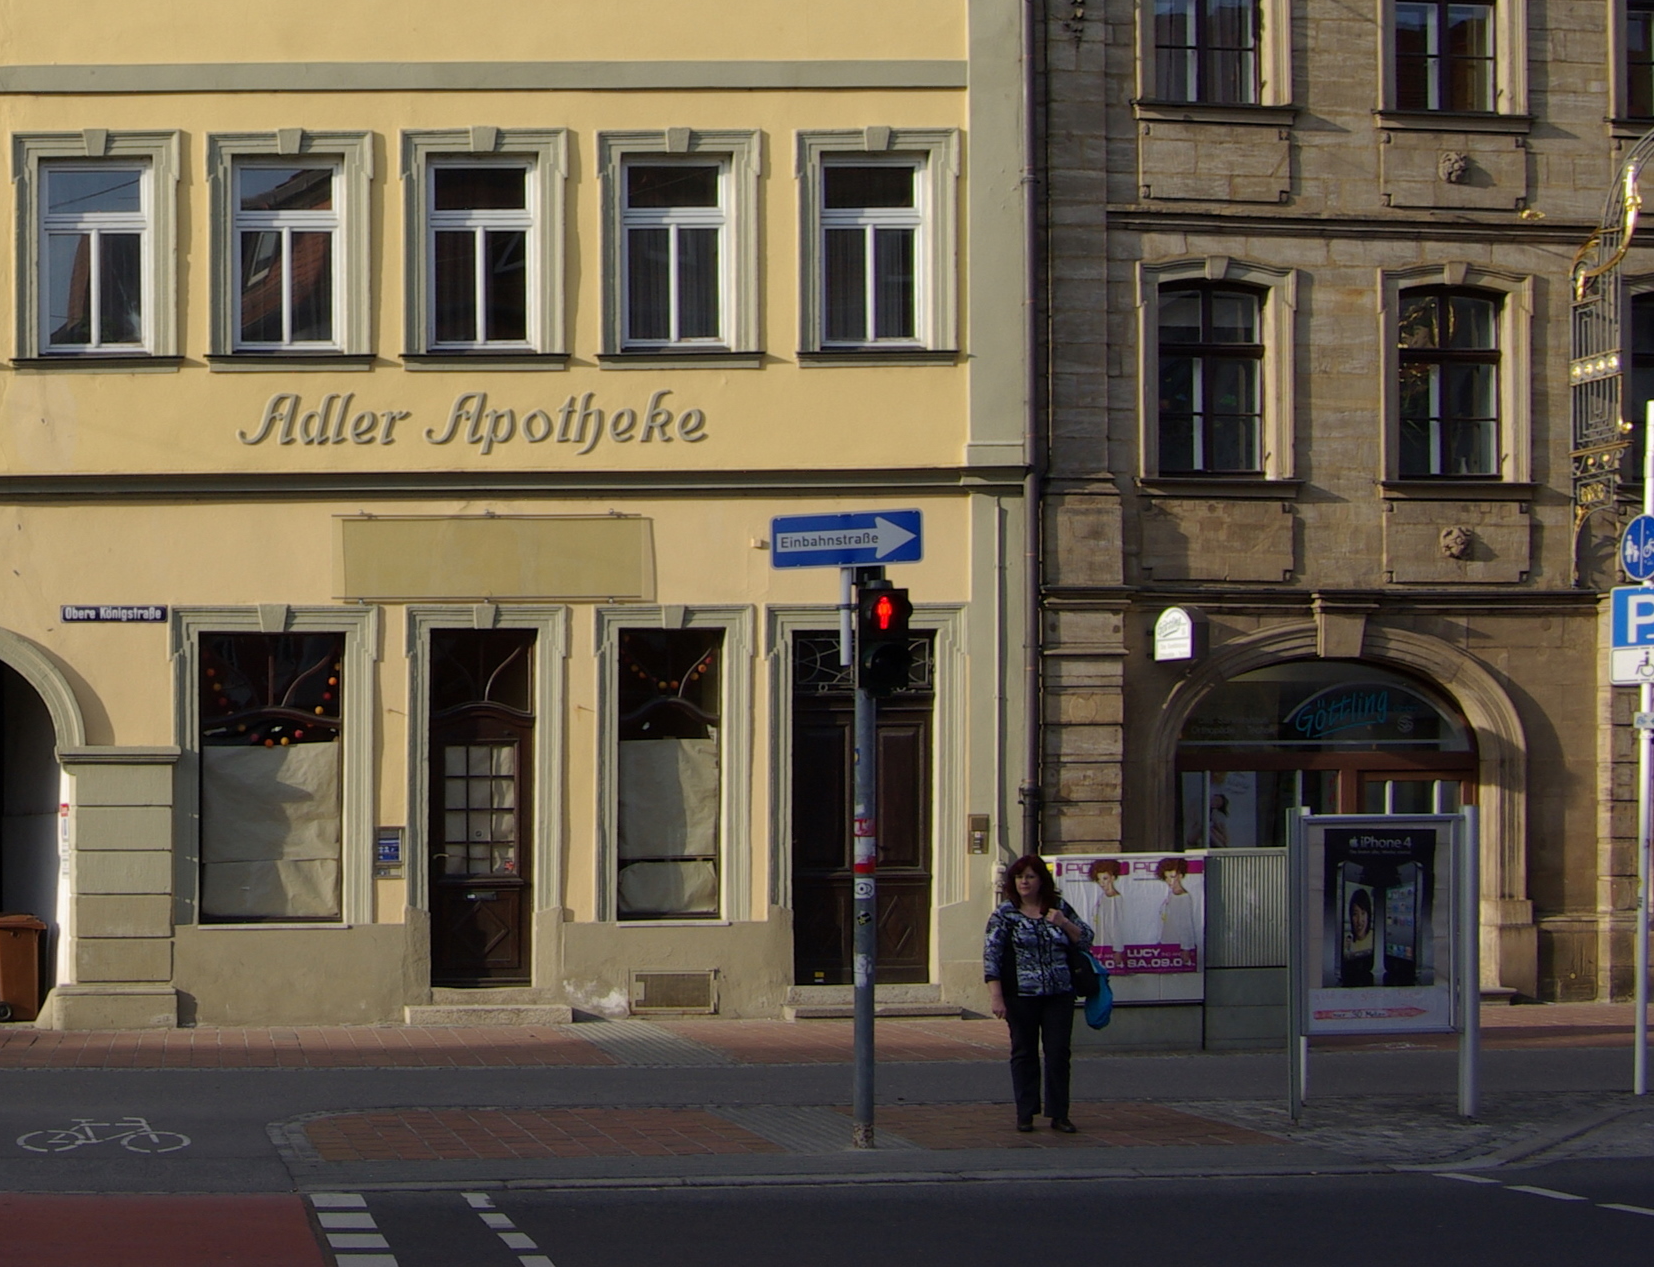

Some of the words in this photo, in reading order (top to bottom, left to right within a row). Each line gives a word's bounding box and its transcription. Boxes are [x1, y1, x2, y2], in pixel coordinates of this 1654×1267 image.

[238, 391, 411, 446] Adler
[422, 388, 708, 456] Apotheke
[780, 532, 879, 549] Einbahnstraße
[65, 606, 96, 620] Obere
[99, 605, 162, 622] Königstraße
[1626, 594, 1654, 646] P
[1294, 690, 1389, 739] Göttling
[1359, 835, 1402, 848] iPhone
[1402, 835, 1412, 848] 4
[1127, 948, 1161, 958] LUCY
